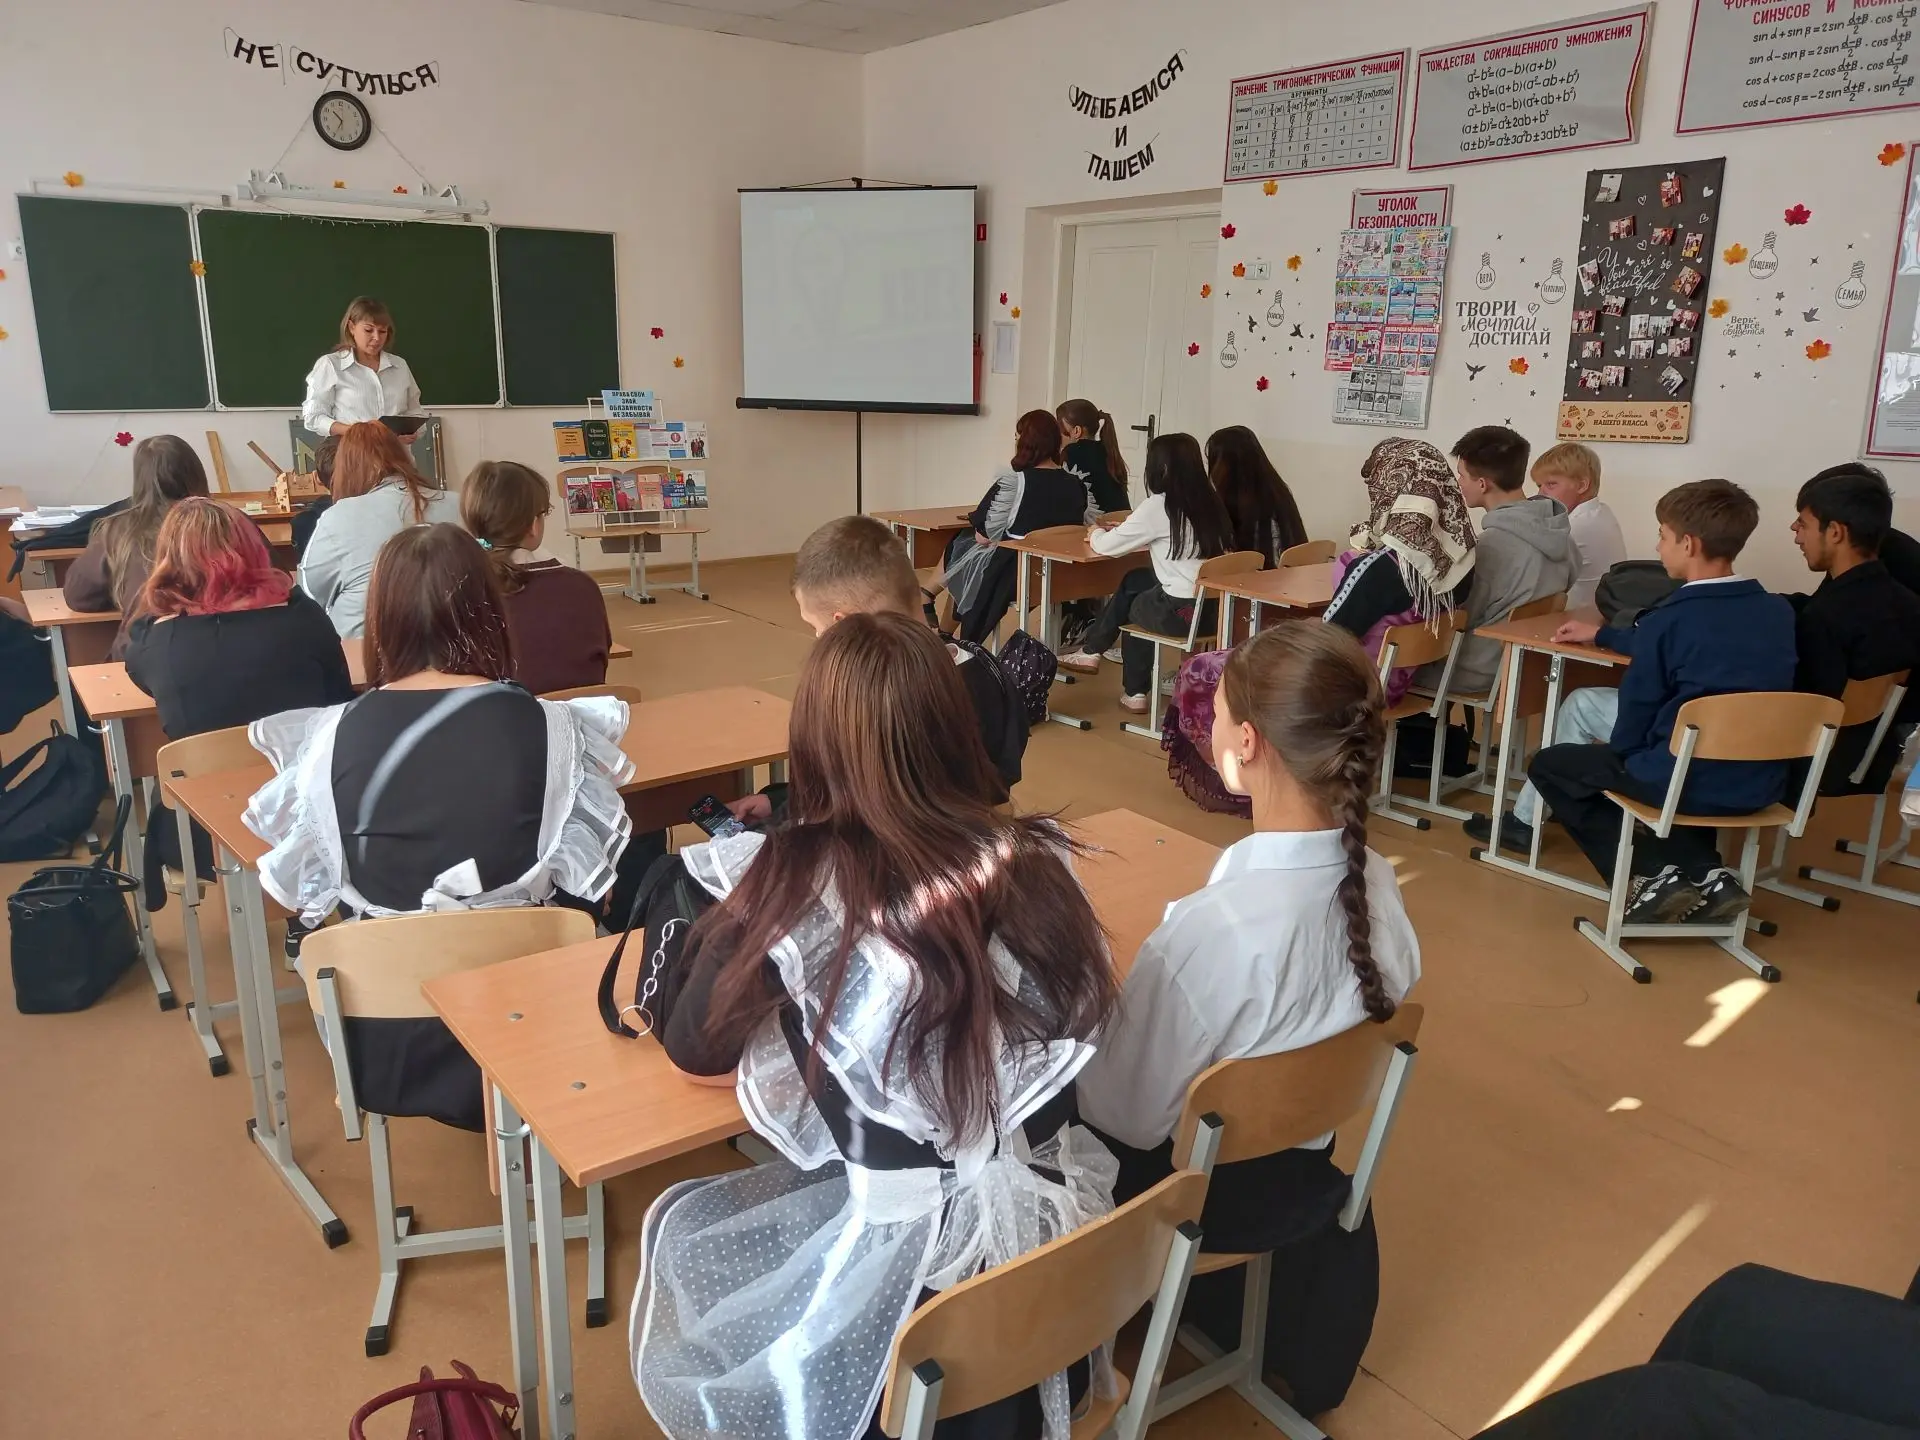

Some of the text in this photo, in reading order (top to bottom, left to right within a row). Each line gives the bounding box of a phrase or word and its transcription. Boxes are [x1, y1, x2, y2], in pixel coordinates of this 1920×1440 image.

[1753, 3, 1811, 25] СИНУСОВ
[1426, 24, 1632, 73] ТОЖДЕСТВА СОКРАЩЕННОГО УМНОЖЕНИЯ
[233, 37, 437, 95] НЕ СУТУЛЬСЯ
[1235, 57, 1400, 97] ЗНАЧЕНИЕ ТРИГОНОМЕТРИЧЕСКИХ ФУНКЦИЙ
[1071, 53, 1184, 119] УЛЫБАЕМСЯ
[1115, 125, 1127, 148] И
[1087, 143, 1154, 181] ПАШЕМ
[1378, 196, 1418, 212] УГОЛОК
[1358, 212, 1438, 230] БЕЗОПАСНОСТИ
[1837, 287, 1864, 301] СЕМЬЯ
[1456, 300, 1516, 317] ТВОРИ
[1469, 328, 1551, 348] ДОСТИГАЙ
